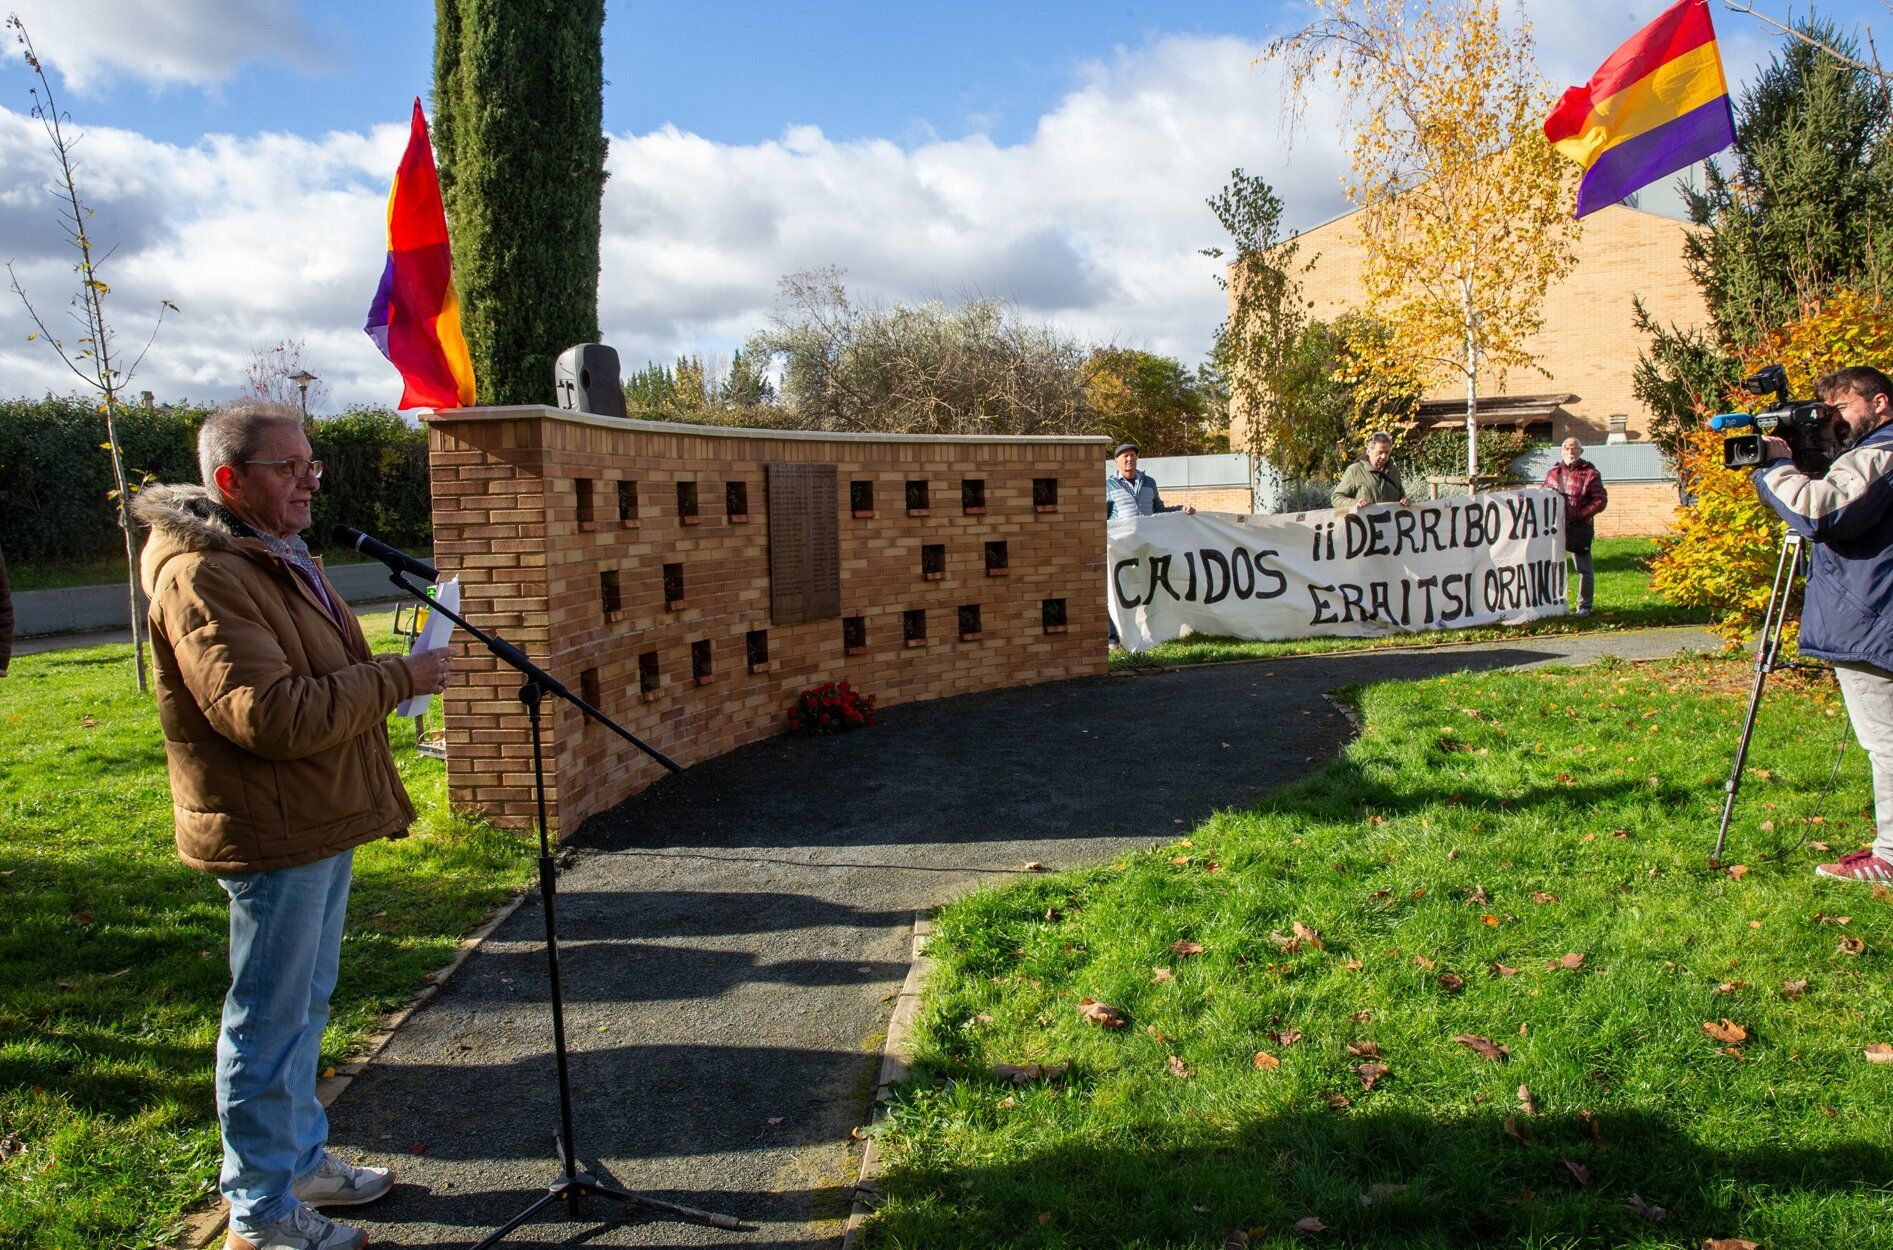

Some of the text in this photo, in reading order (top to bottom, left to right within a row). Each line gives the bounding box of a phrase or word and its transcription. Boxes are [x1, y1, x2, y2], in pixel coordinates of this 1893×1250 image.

[1810, 409, 1818, 419] 4
[1114, 547, 1288, 609] CAIDOS
[1308, 560, 1566, 626] ERAITSI ORAIN!!
